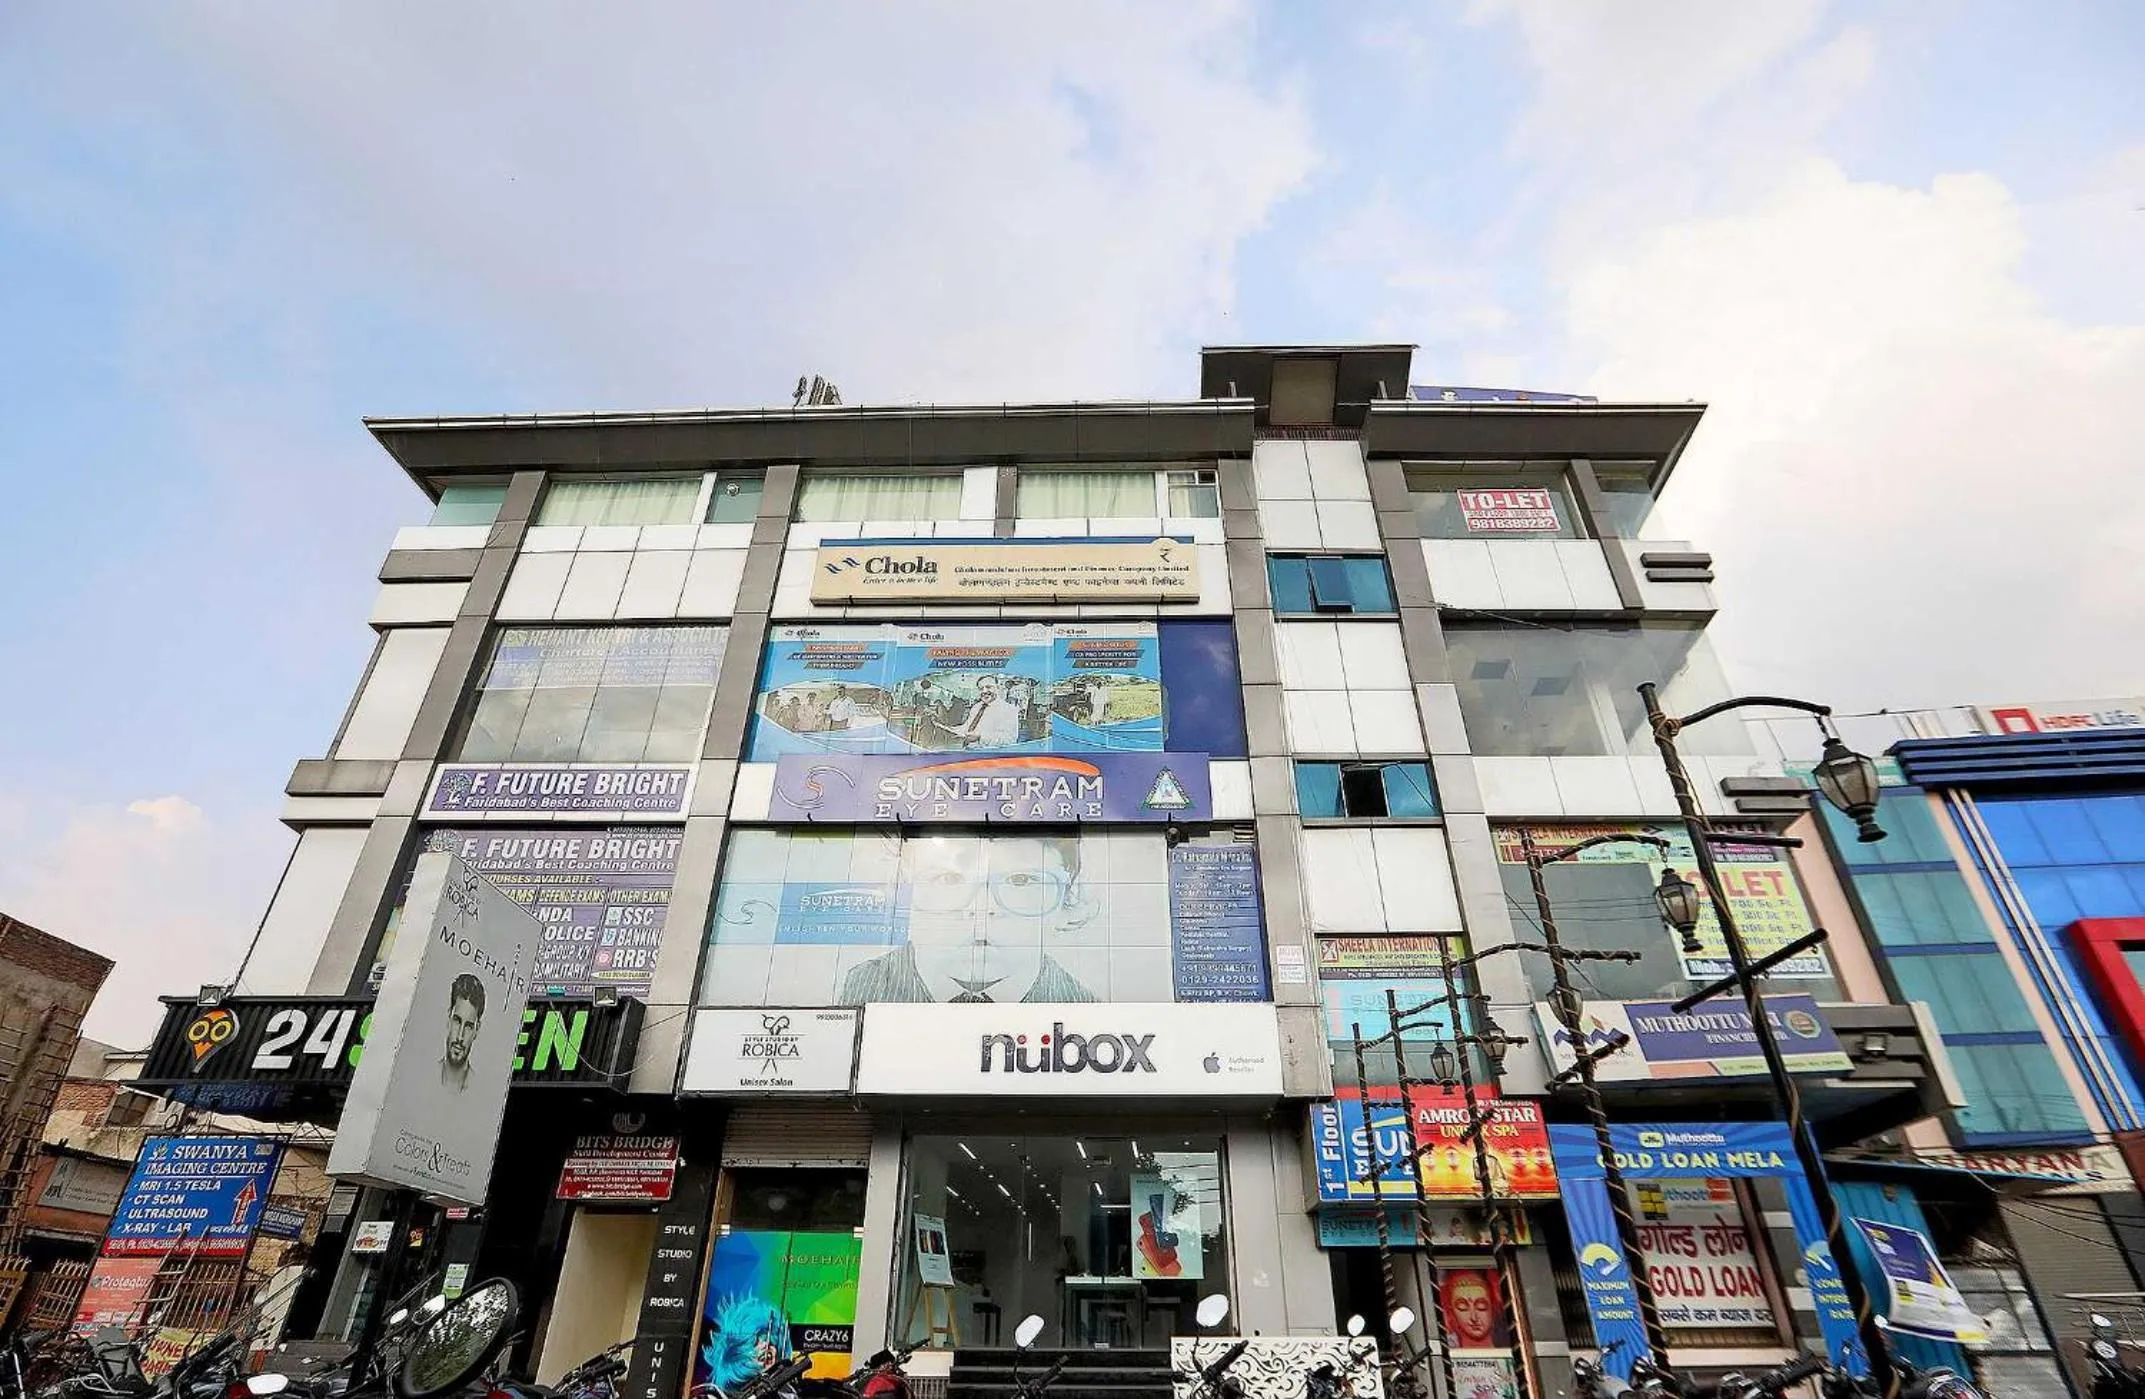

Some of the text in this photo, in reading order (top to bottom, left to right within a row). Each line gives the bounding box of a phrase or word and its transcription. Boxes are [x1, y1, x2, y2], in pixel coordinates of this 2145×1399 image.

[1462, 493, 1546, 509] TO-LET
[864, 556, 938, 574] Chola
[495, 773, 589, 795] FUTURE
[594, 773, 684, 795] BRIGHT
[877, 776, 1103, 801] SUNETRAM
[465, 797, 676, 809] Faridabad's Best Coaching Centre
[875, 803, 1103, 818] EYE CARE
[486, 839, 580, 859] FUTURE
[584, 838, 681, 859] BRIGHT
[535, 859, 564, 870] Best
[567, 859, 626, 872] Coaching
[629, 859, 675, 870] Centre
[488, 875, 532, 884] OURSES
[534, 875, 593, 884] AVAILABLE
[1721, 871, 1786, 897] LET
[801, 895, 885, 906] SUNETRAM
[623, 907, 655, 925] SSC
[544, 926, 595, 941] OLICE
[1337, 937, 1376, 951] SHEELA
[1635, 1012, 1740, 1035] MUTHOOTTU
[251, 1009, 589, 1071] 24SEN
[742, 1043, 799, 1057] ROBICA
[740, 1078, 793, 1086] Unisex Salon
[1492, 1107, 1538, 1123] STAR
[1321, 1104, 1342, 1161] Floor
[1492, 1124, 1520, 1137] SPA
[576, 1135, 675, 1149] BITS BRIDGE
[171, 1146, 248, 1160] SWANYA
[1660, 1153, 1720, 1169] LOAN
[1725, 1152, 1785, 1168] MELA
[144, 1162, 267, 1175] IMAGING CENTRE
[138, 1180, 222, 1191] MRI 1.5 TESLA
[133, 1195, 149, 1205] CT
[151, 1194, 185, 1205] SCAN
[128, 1208, 209, 1219] ULTRASOUND
[122, 1222, 158, 1234] X-RAY
[664, 1225, 696, 1236] STYLE
[1635, 1213, 1749, 1258] गोल्ड लोन
[657, 1249, 693, 1259] STUDIO
[664, 1274, 677, 1283] BY
[1650, 1265, 1765, 1298] GOLD LOAN
[1588, 1282, 1630, 1291] MAXIMUM
[649, 1297, 685, 1308] ROBICA
[1600, 1296, 1625, 1305] LOAN
[1597, 1311, 1634, 1320] AMOUNT
[1658, 1305, 1691, 1322] सबसे
[1692, 1309, 1718, 1321] कम
[804, 1329, 849, 1342] CRAZY6
